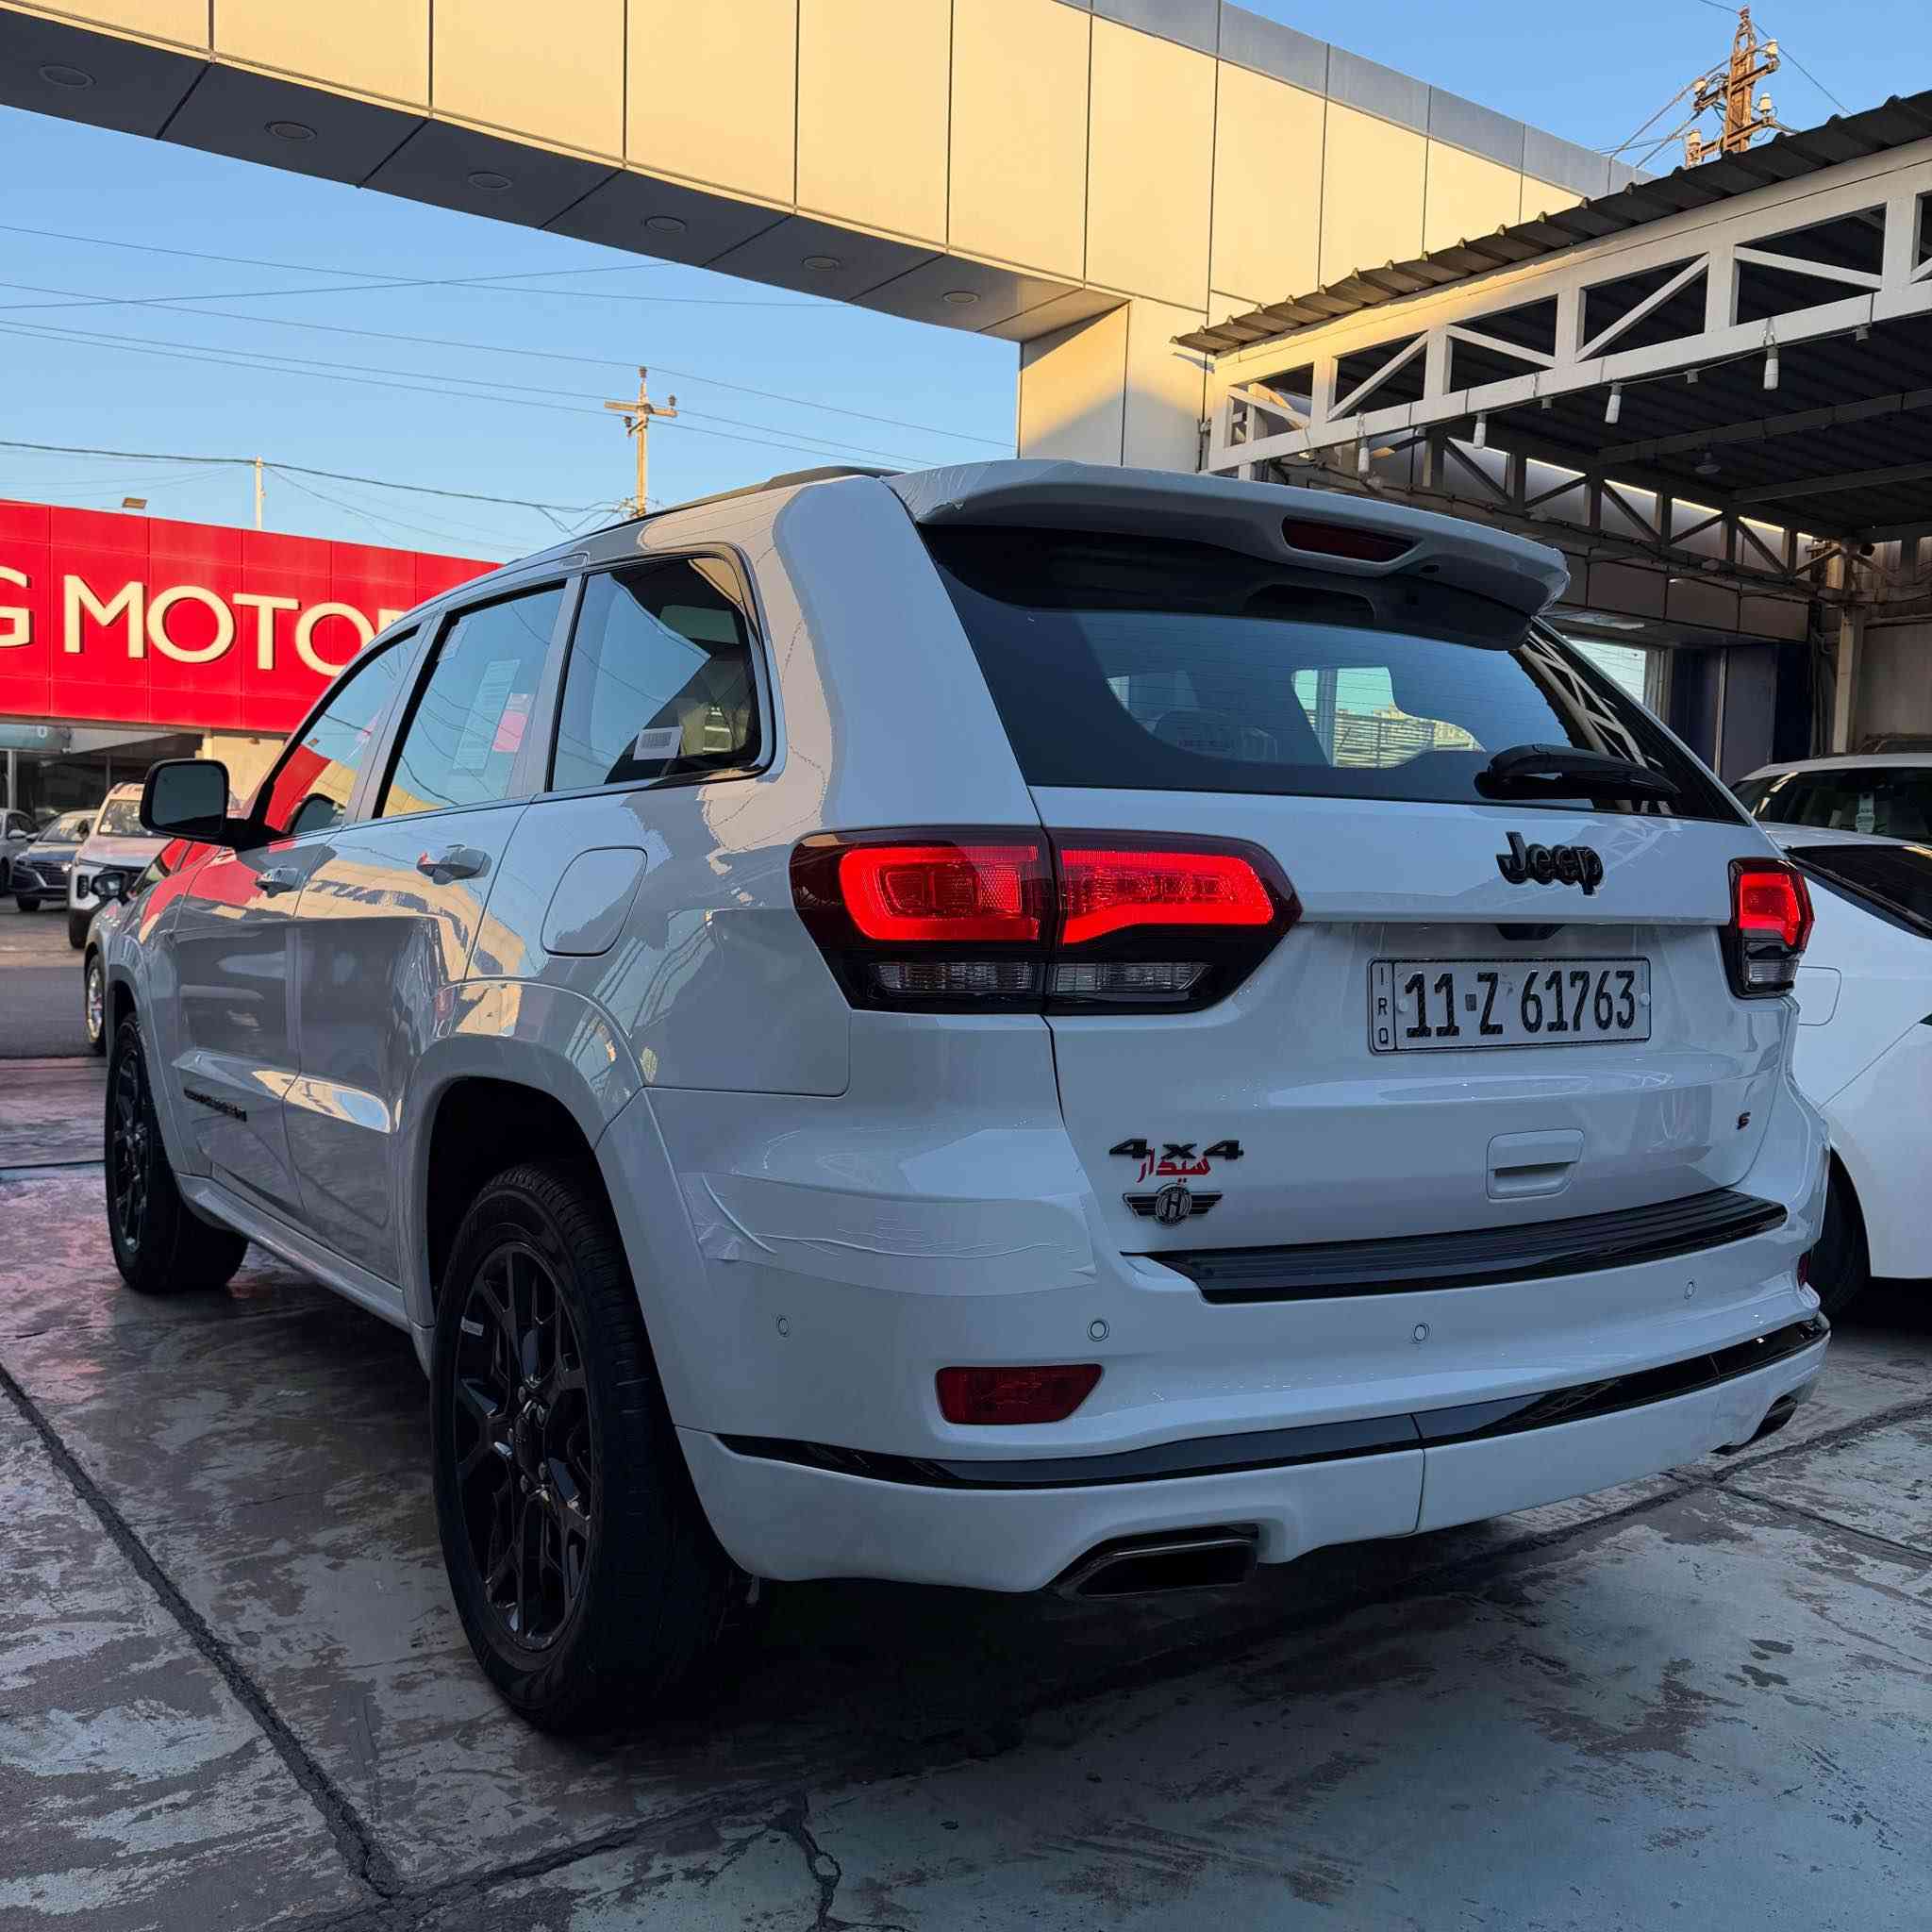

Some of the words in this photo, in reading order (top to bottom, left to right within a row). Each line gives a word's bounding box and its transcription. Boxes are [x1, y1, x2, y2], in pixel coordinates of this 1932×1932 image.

[64, 575, 403, 677] MOTO
[1495, 831, 1604, 895] Jeep
[1405, 973, 1459, 1038] 11
[1521, 970, 1636, 1034] 61763
